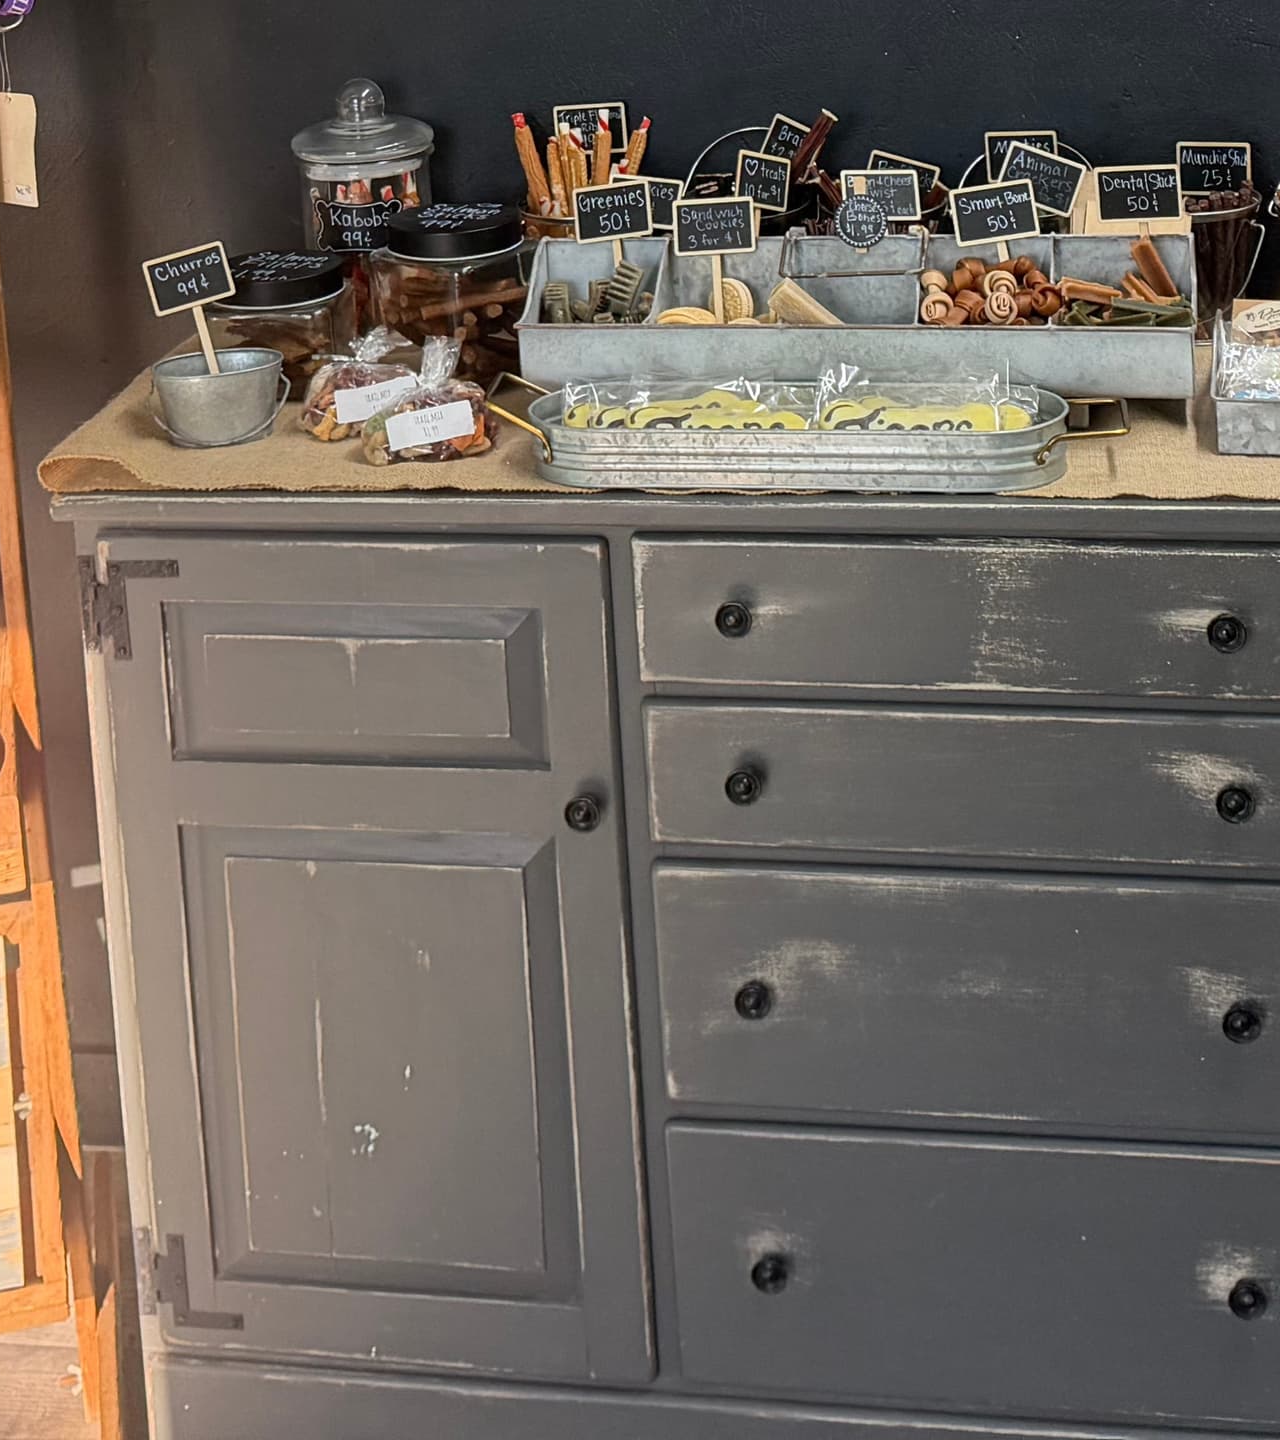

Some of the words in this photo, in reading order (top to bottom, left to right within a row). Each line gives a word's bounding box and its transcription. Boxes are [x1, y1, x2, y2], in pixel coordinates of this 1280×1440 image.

[761, 162, 786, 181] treats
[1012, 149, 1069, 178] Animal
[1102, 172, 1150, 193] Dental
[577, 188, 645, 214] Greenies
[958, 195, 1003, 215] Smart
[680, 205, 744, 225] Sandwich
[695, 218, 745, 232] Cookies
[846, 210, 881, 224] Bones
[687, 234, 698, 249] 3
[701, 233, 720, 246] for
[154, 251, 221, 282] Churros
